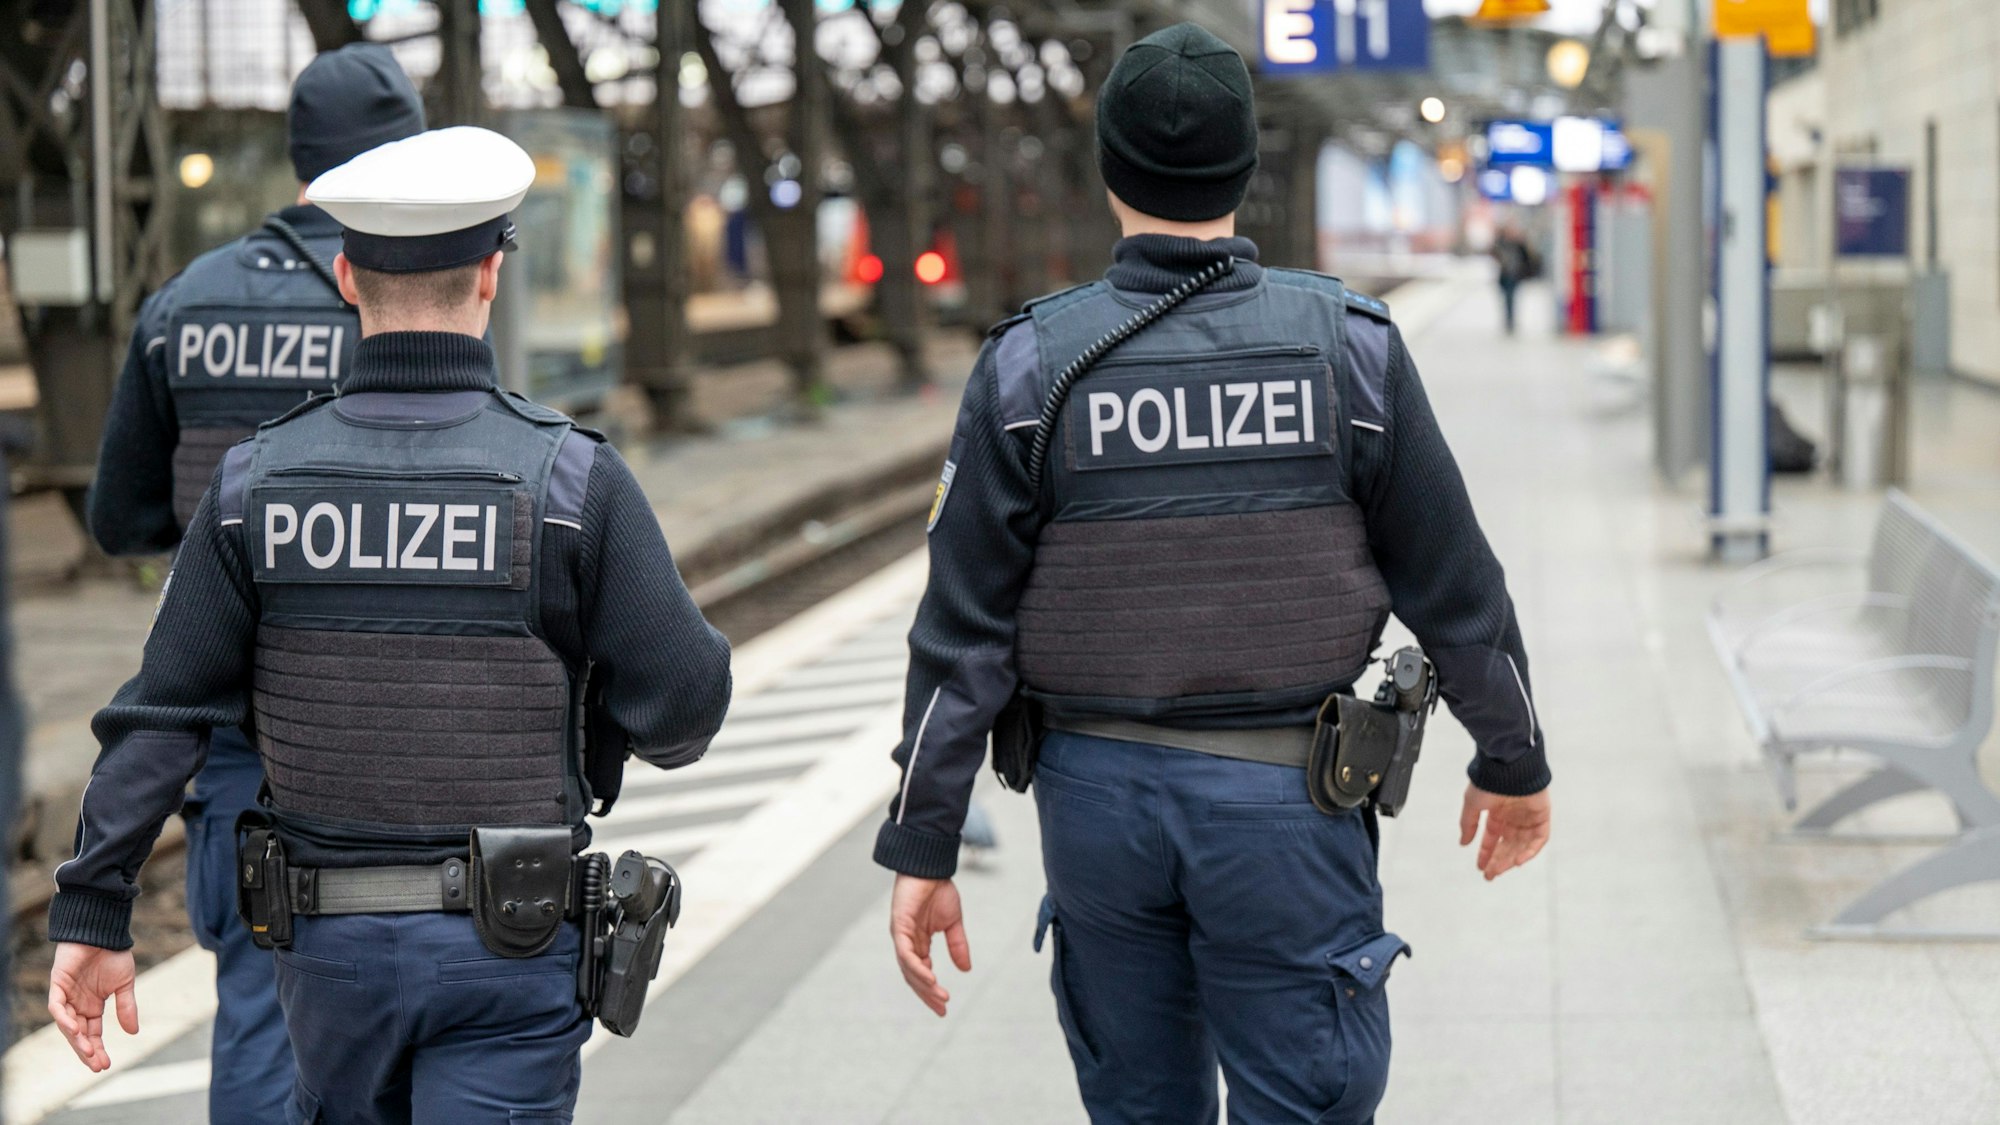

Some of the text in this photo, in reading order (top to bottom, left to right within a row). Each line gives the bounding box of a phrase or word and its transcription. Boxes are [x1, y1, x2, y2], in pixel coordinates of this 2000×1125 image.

[1263, 0, 1317, 64] E
[179, 323, 344, 379] POLIZEI
[1088, 380, 1315, 456] POLIZEI
[264, 502, 497, 571] POLIZEI
